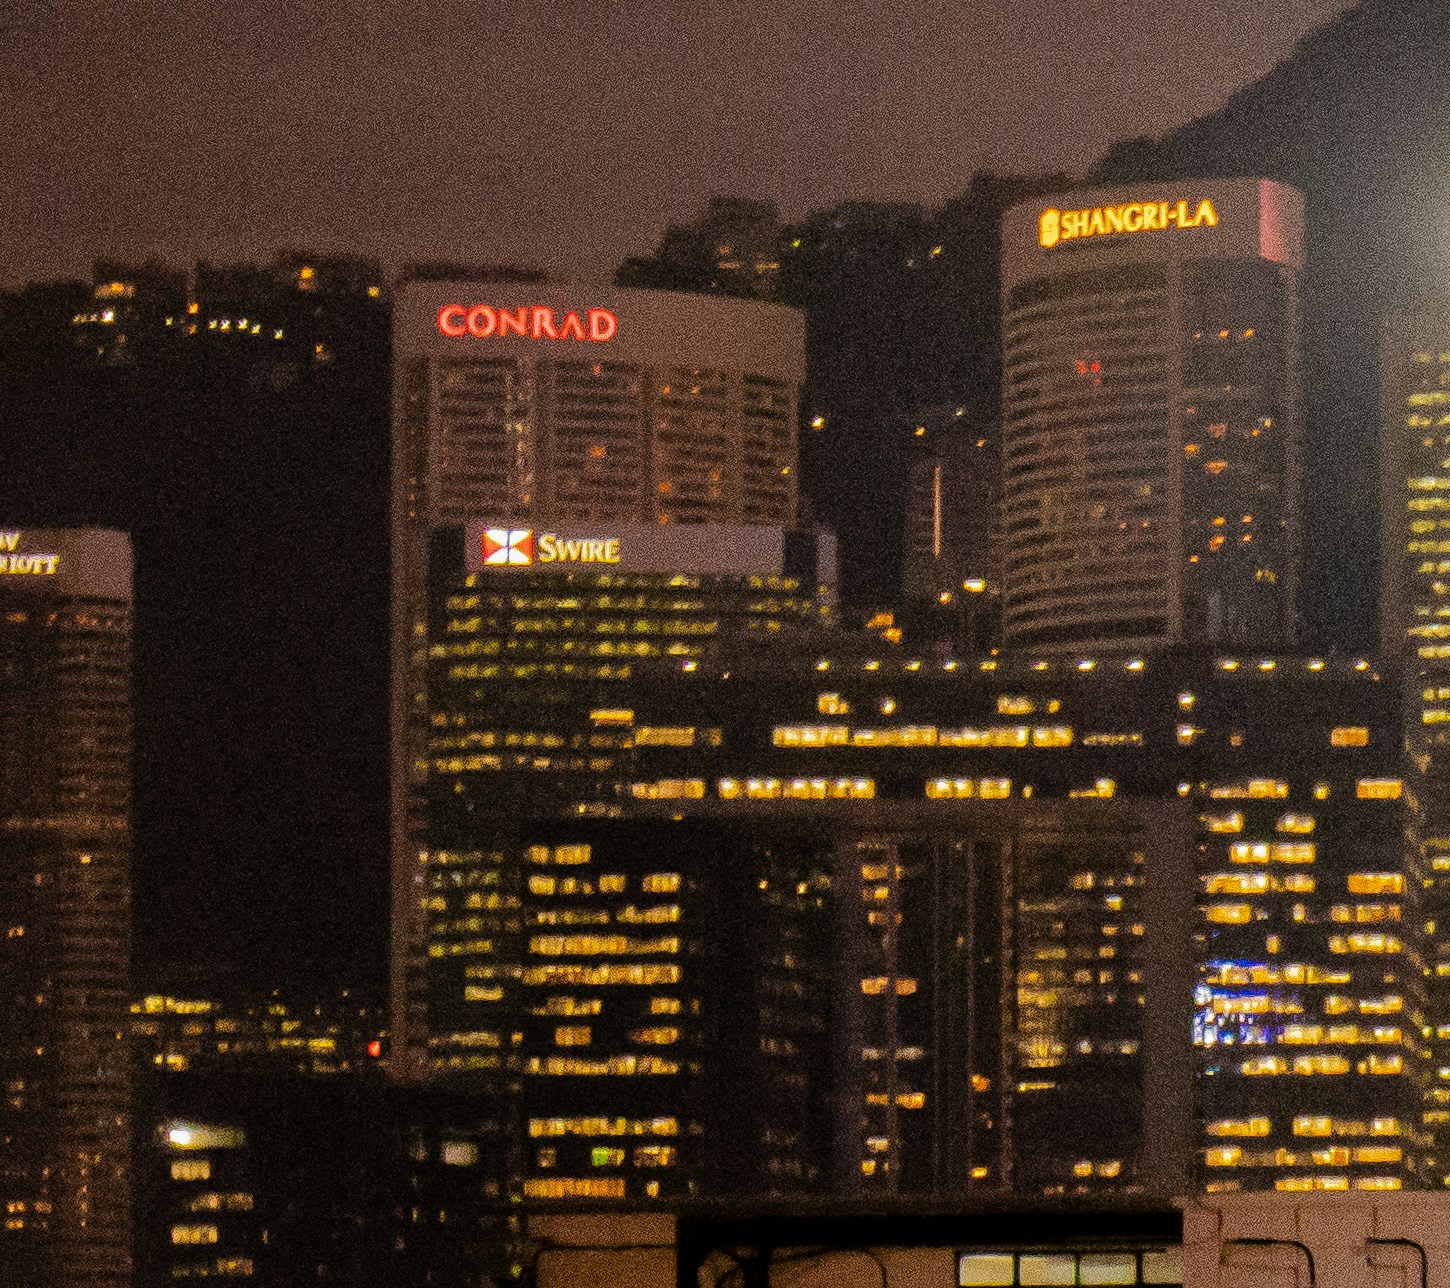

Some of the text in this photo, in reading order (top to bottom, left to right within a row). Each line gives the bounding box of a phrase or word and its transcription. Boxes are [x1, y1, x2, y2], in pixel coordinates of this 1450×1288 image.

[1060, 199, 1219, 240] SHANGRI-LA
[437, 303, 618, 342] CONRAD
[538, 532, 621, 564] SWIRE
